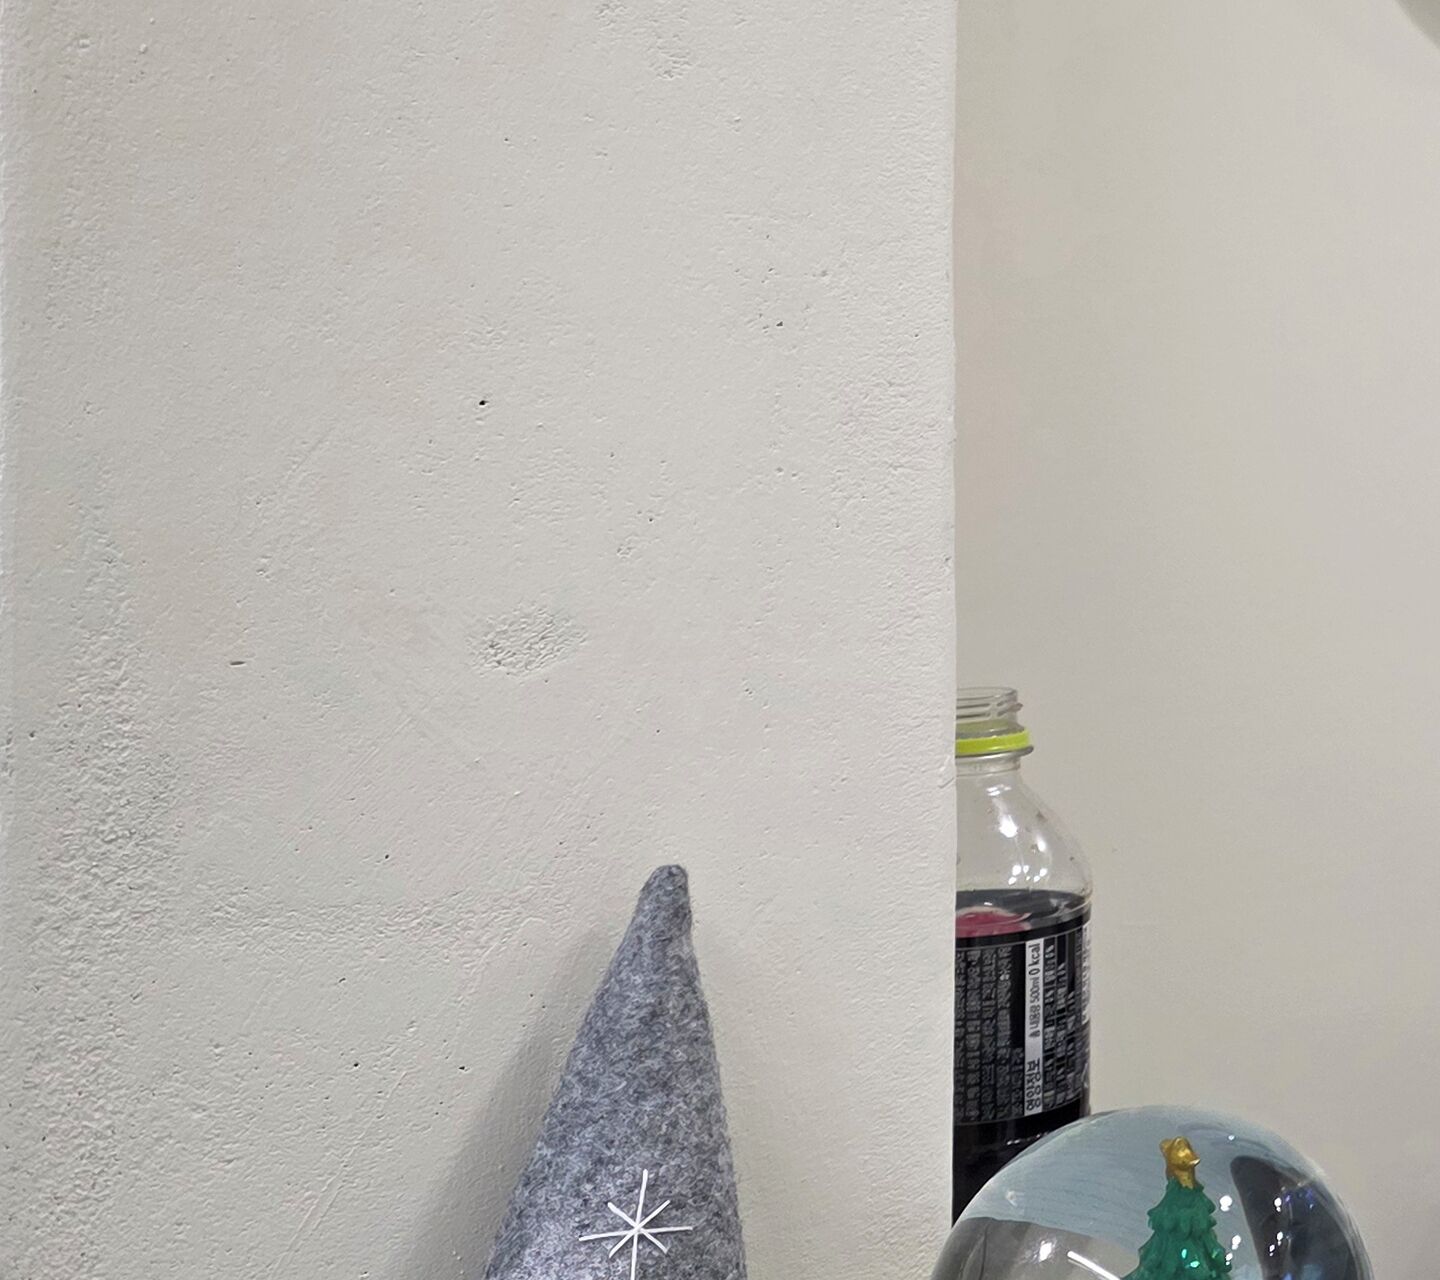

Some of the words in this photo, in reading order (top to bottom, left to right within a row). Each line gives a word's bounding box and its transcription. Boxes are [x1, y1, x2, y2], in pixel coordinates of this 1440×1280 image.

[1027, 942, 1041, 968] kcal
[1027, 968, 1040, 976] 0
[1026, 1058, 1041, 1112] 영양정보
